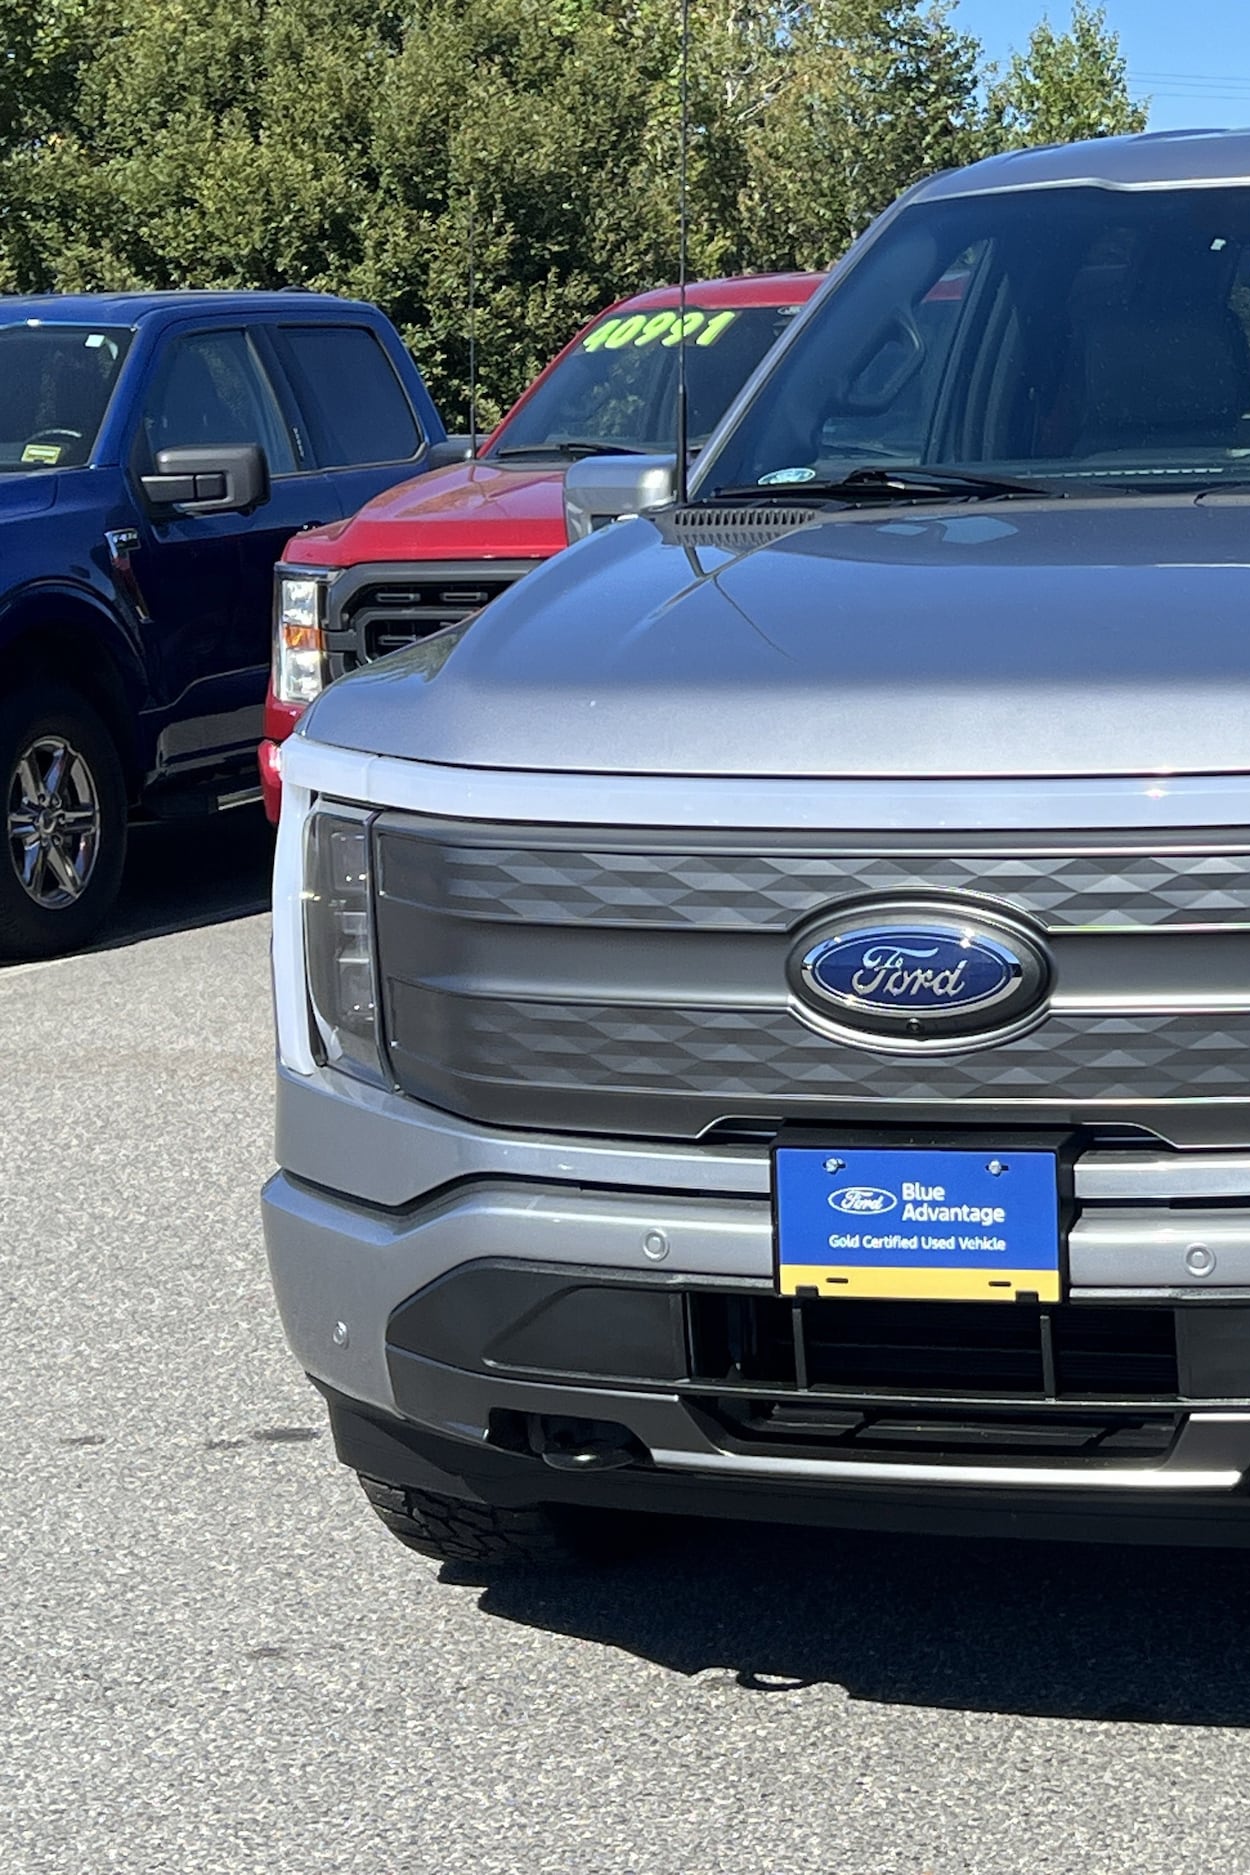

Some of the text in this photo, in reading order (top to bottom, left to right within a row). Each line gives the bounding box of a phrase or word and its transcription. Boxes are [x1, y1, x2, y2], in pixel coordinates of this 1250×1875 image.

[583, 311, 735, 352] 40991
[852, 945, 969, 996] Ford
[840, 1190, 884, 1211] Ford
[902, 1182, 945, 1201] Blue
[902, 1204, 1006, 1226] Advantage
[828, 1234, 1006, 1252] Gold Certified Used Vehicle
